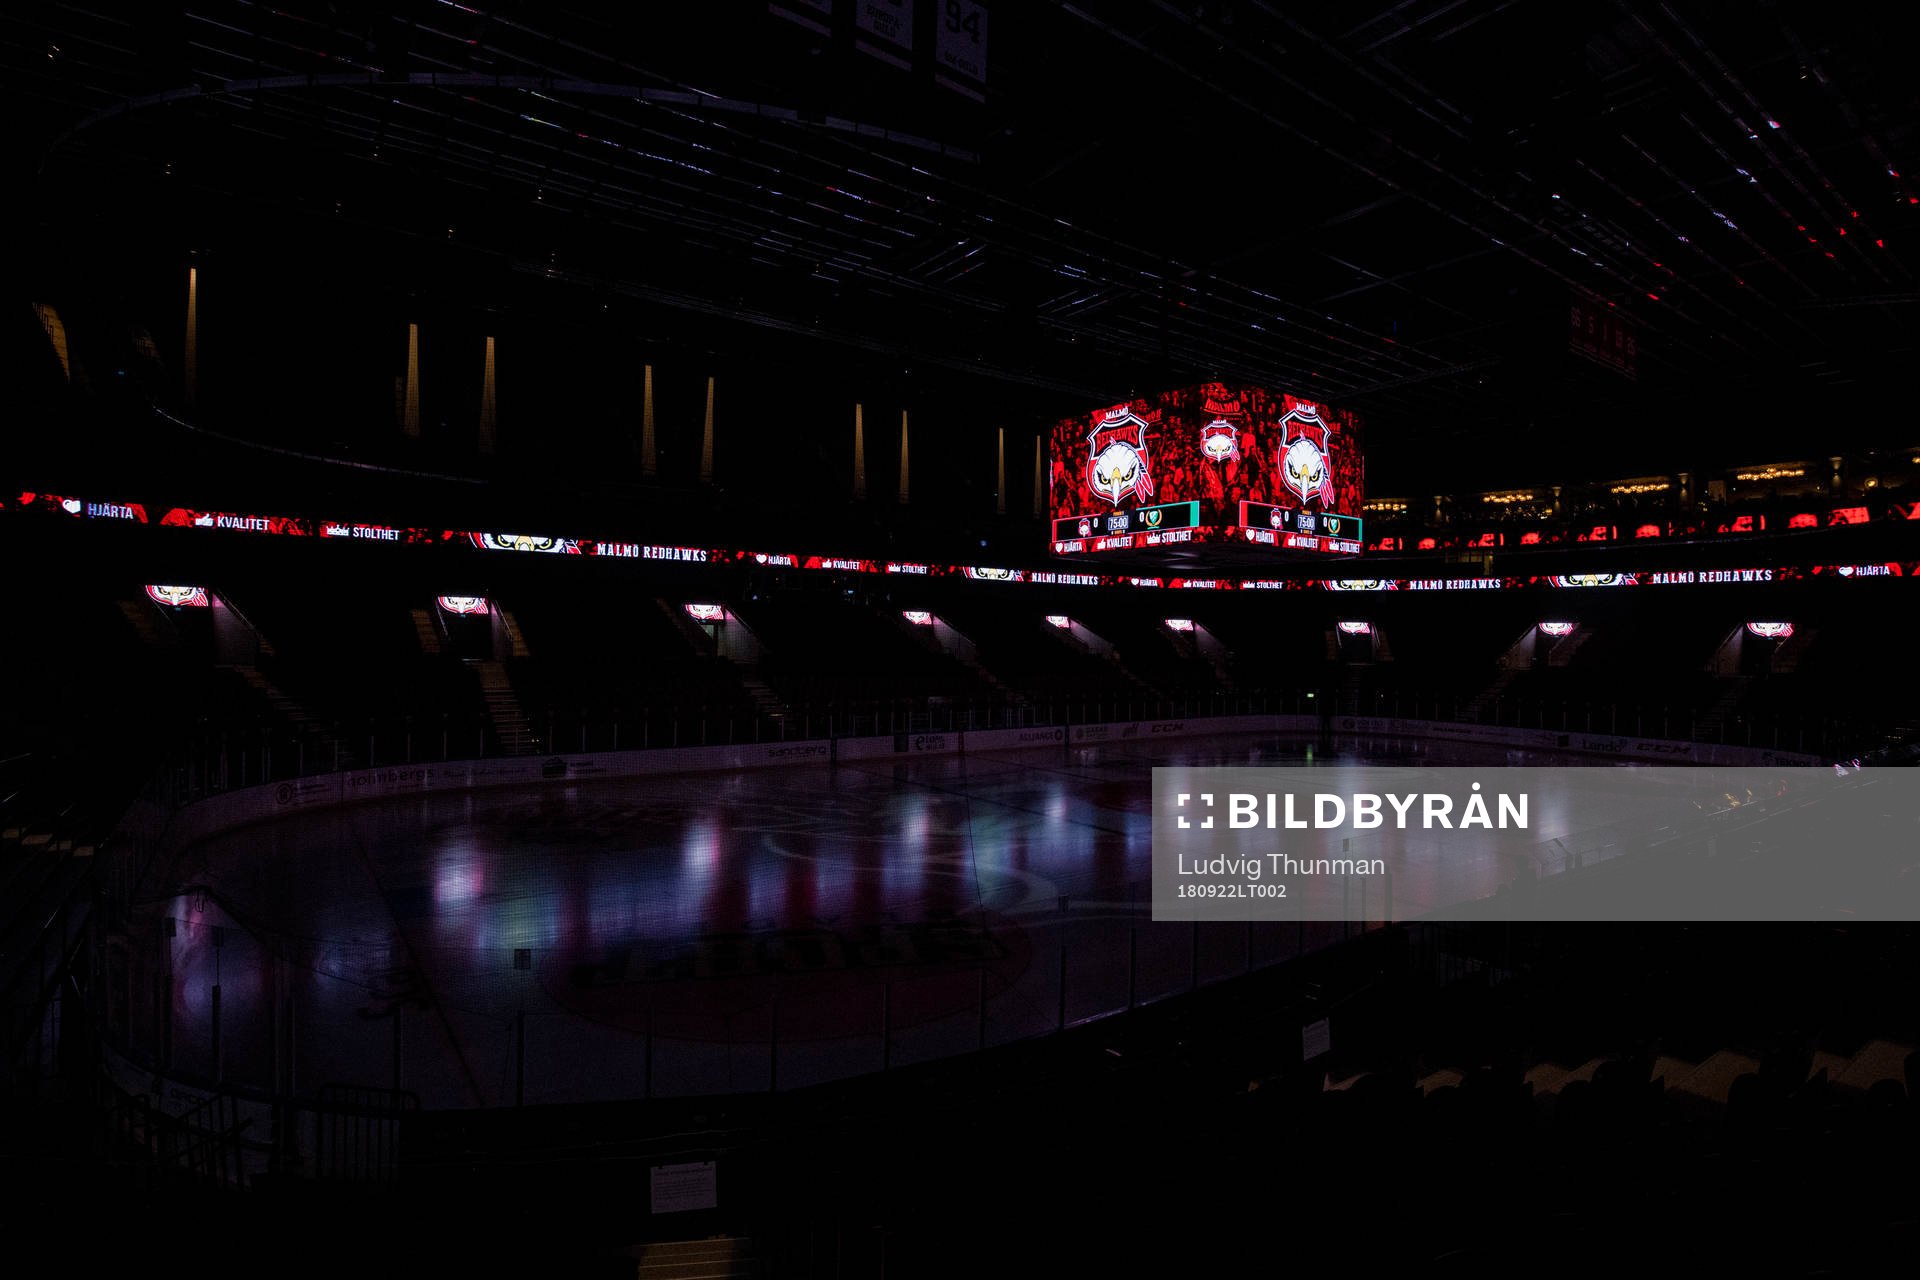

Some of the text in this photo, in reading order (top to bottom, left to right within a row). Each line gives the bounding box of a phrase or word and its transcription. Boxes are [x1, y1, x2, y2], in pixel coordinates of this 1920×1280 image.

[946, 0, 982, 44] 94
[87, 502, 134, 519] HJÄRTA
[217, 515, 270, 531] KVALITET
[352, 526, 400, 541] STOLTHET
[1161, 530, 1192, 543] STOLTHET
[1107, 536, 1132, 548] KVALITET
[643, 545, 707, 562] REDHAWKS
[768, 554, 791, 566] HJÄRTA
[833, 559, 860, 570] KVALITET
[901, 565, 928, 575] STOLTHET
[1856, 565, 1890, 576] HJÄRTA
[1699, 569, 1772, 583] REDHAWKS
[1446, 578, 1501, 590] REDHAWKS
